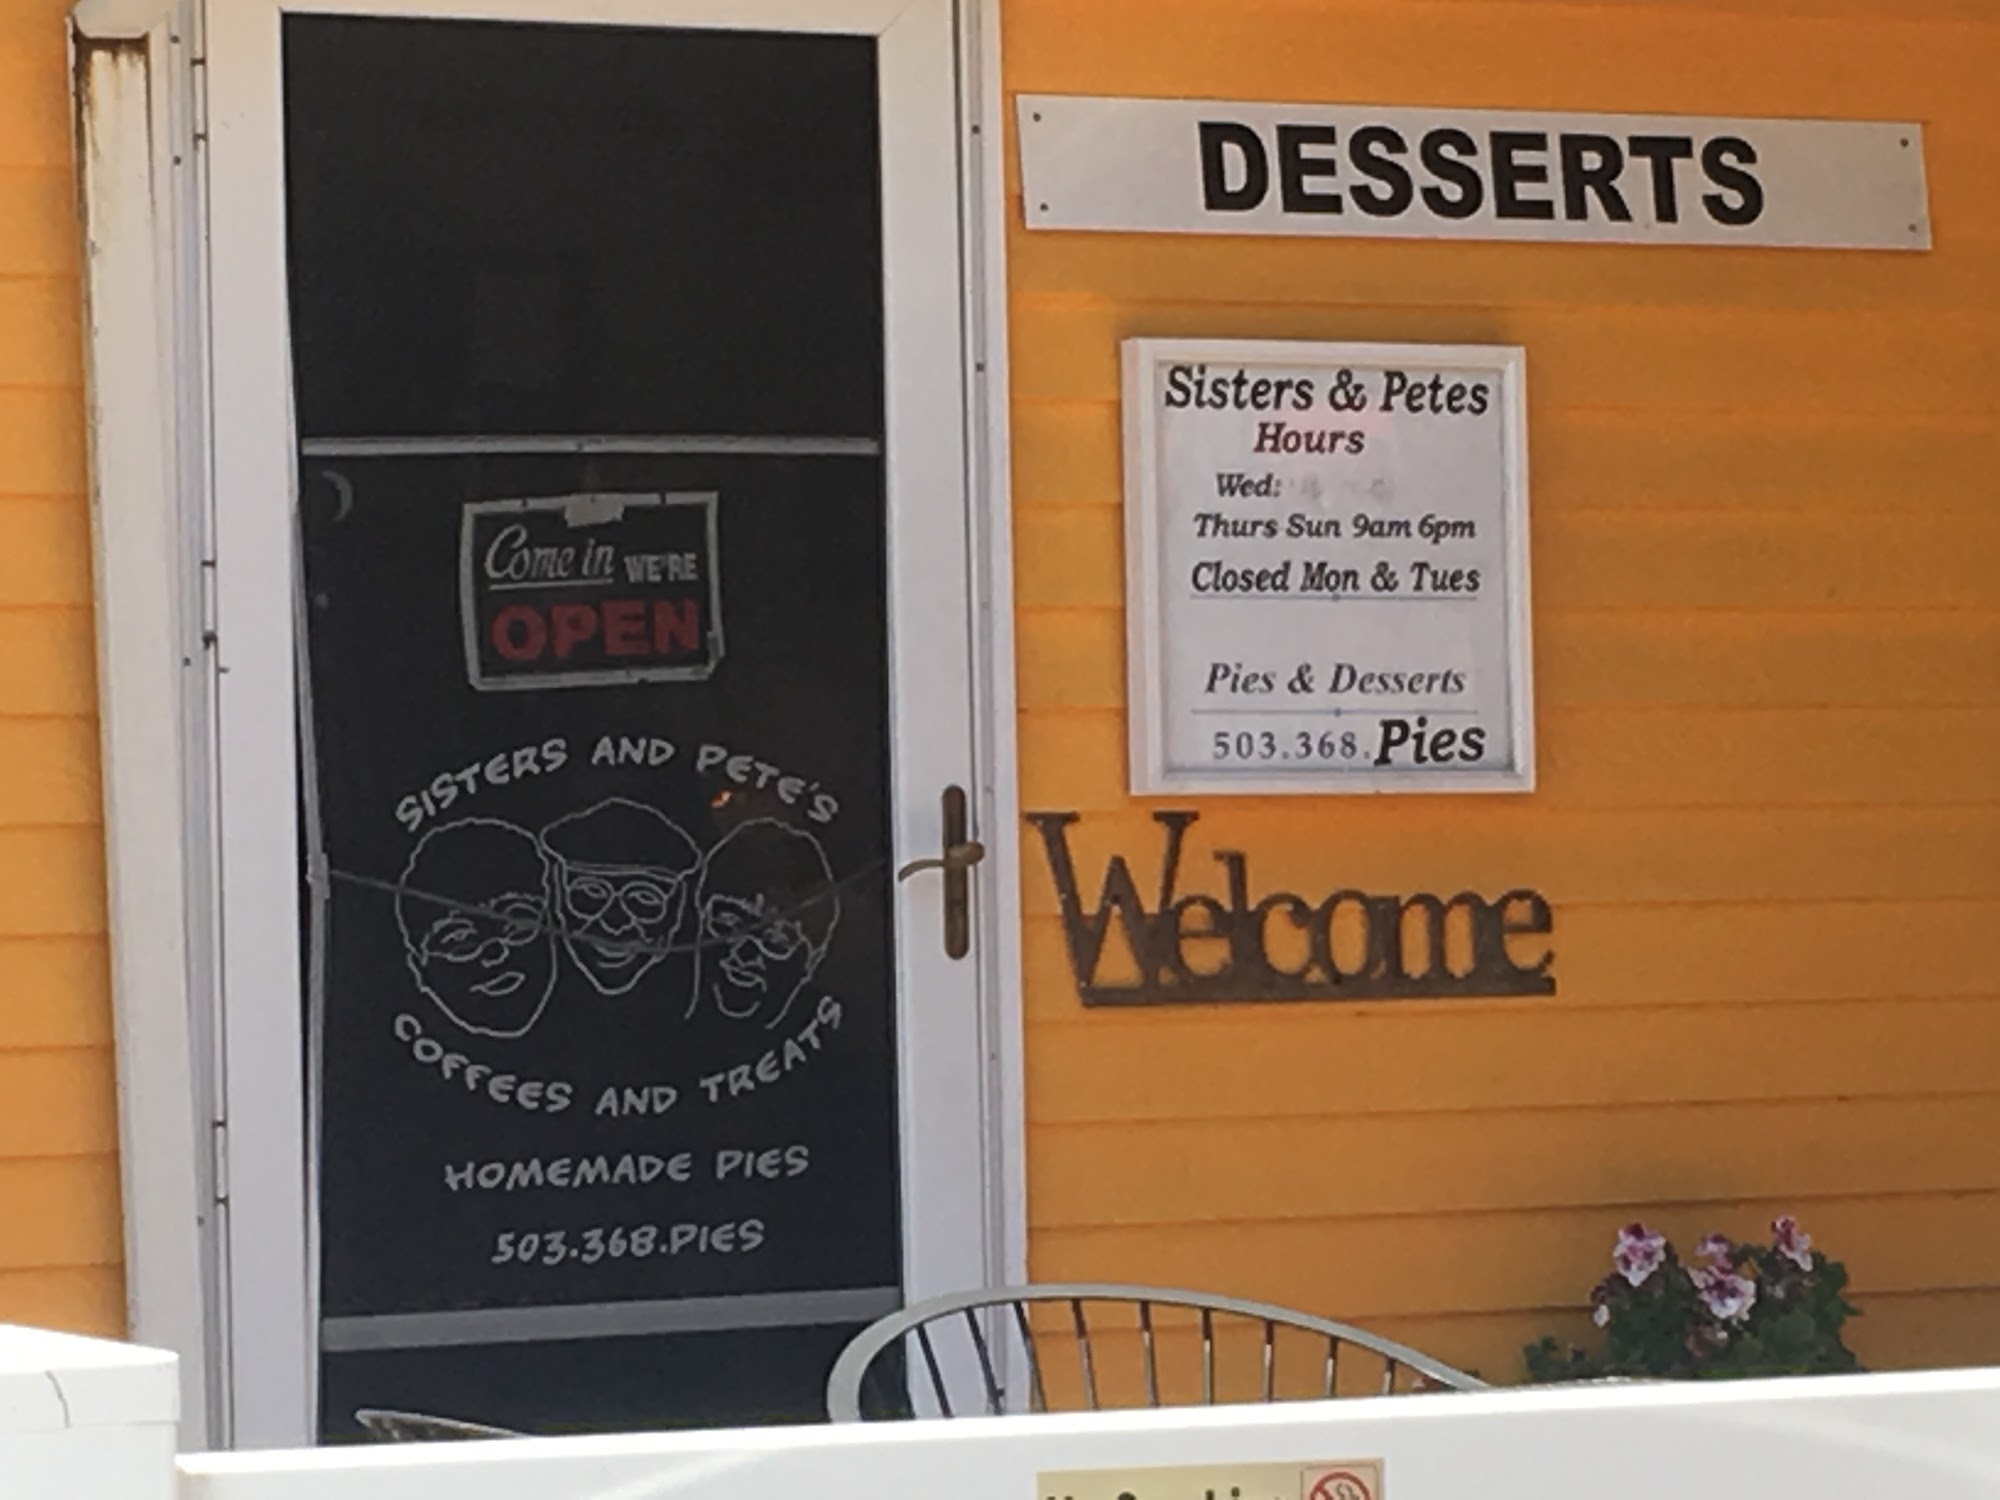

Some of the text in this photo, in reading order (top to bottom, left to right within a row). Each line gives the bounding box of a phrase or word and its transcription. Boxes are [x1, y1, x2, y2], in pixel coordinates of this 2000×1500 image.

[1198, 120, 1764, 227] DESSERTS
[1164, 364, 1490, 415] Sisters & Petes
[1253, 422, 1366, 454] Hours
[1215, 473, 1282, 498] Wed:
[484, 523, 698, 583] Come in WE'RE
[1193, 513, 1476, 545] Thurs Sun 9am 6pm
[1191, 562, 1481, 593] Closed Mon & Tues
[491, 597, 700, 661] OPEN
[1204, 662, 1466, 695] Pies & Desserts
[395, 736, 838, 831] SISTERS AND PETE'S
[1026, 811, 1556, 1007] Welcome
[394, 995, 843, 1116] COFFEES AND TREATS
[444, 1145, 809, 1191] HOMEMADE PIES
[490, 1219, 766, 1264] 503.368.PIES
